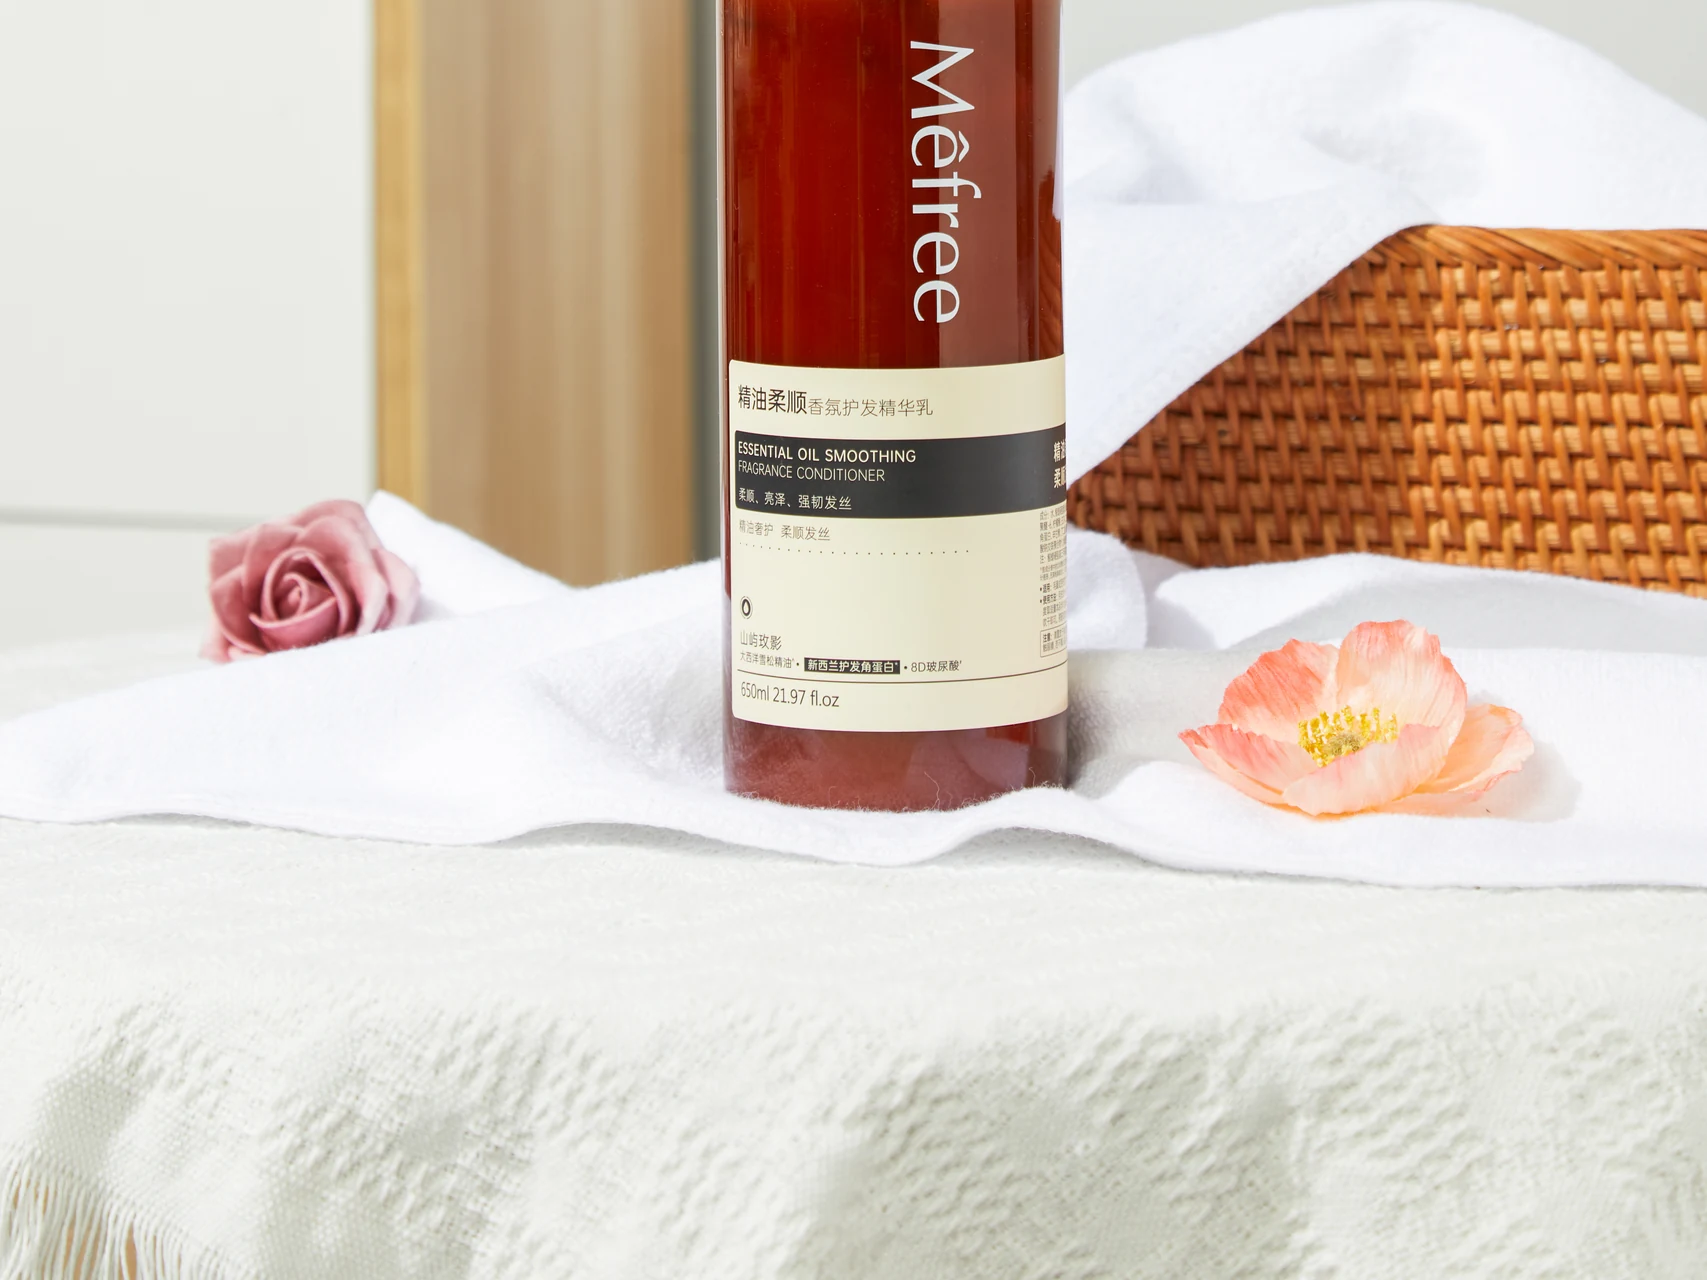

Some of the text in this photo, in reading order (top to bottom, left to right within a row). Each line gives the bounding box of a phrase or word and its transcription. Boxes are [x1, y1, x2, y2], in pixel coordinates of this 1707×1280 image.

[910, 40, 982, 323] Mêfree
[738, 440, 917, 464] ESSENTIAL OIL SMOOTHING
[738, 459, 885, 482] FRAGRANCE CONDITIONER
[781, 524, 831, 541] 柔顺发丝
[741, 681, 840, 708] 650ml 21.97 fl.oz
